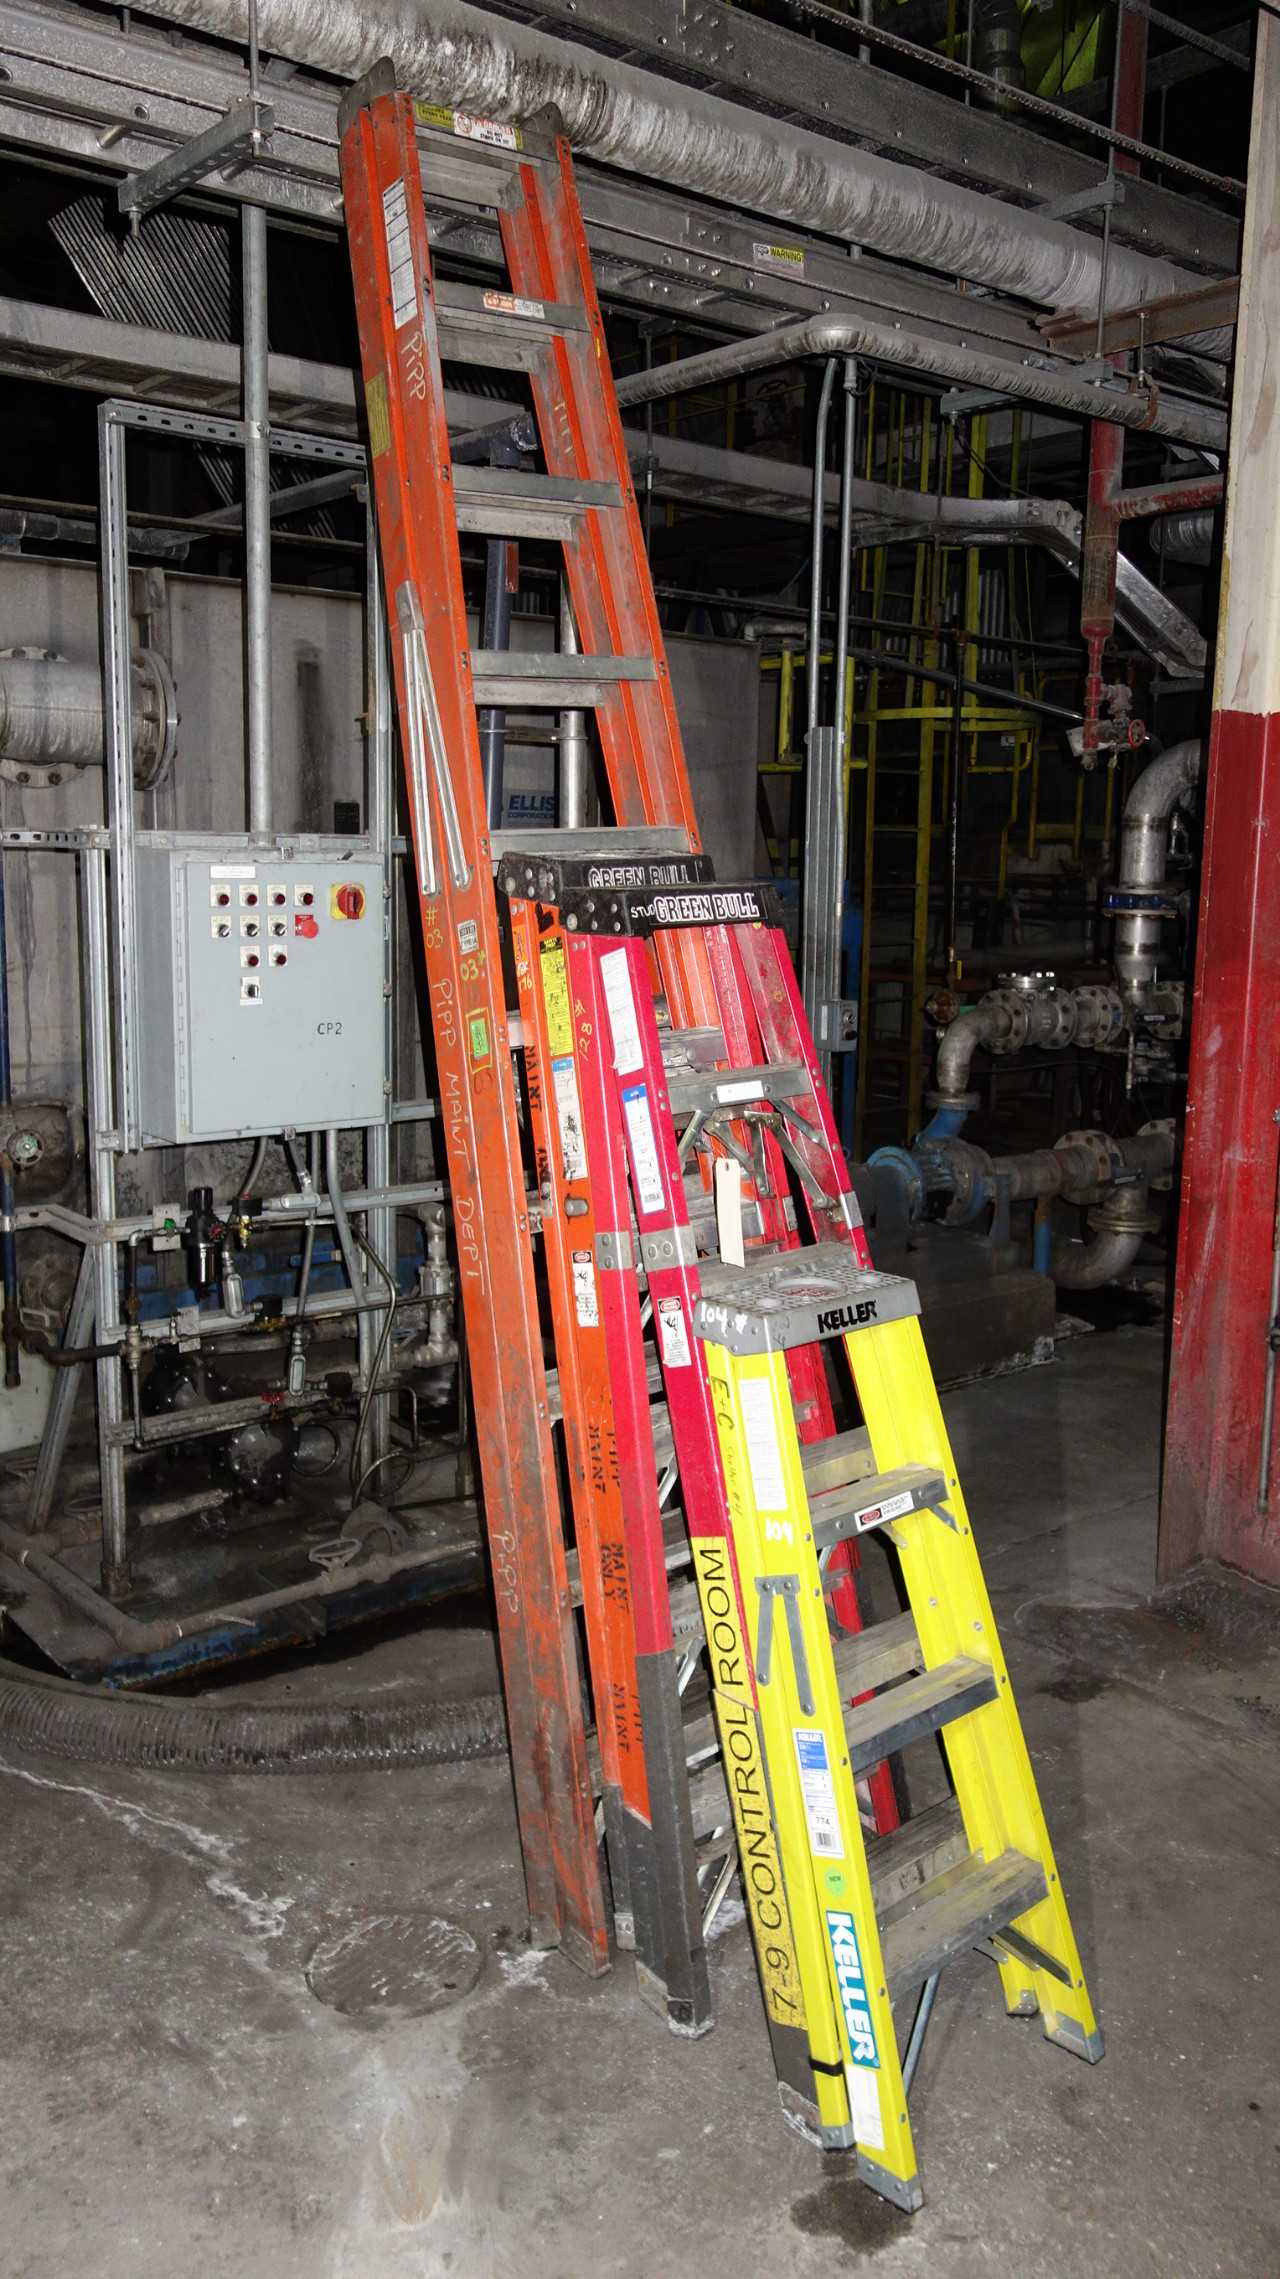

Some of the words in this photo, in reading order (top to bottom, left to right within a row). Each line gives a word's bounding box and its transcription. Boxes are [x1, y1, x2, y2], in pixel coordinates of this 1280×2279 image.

[771, 247, 802, 262] WARNING
[509, 795, 553, 811] ELLIS
[588, 866, 646, 888] GREEN
[650, 864, 691, 885] BULL
[653, 895, 714, 922] GREEN
[713, 892, 760, 918] BULL
[317, 1022, 343, 1035] CP2
[456, 1195, 485, 1297] DEPT
[817, 1299, 878, 1334] KELLER
[699, 1549, 744, 1686] ROOM
[725, 1706, 783, 1931] CONTROL
[766, 1946, 798, 2011] 7-9
[827, 1911, 876, 2061] KELLER
